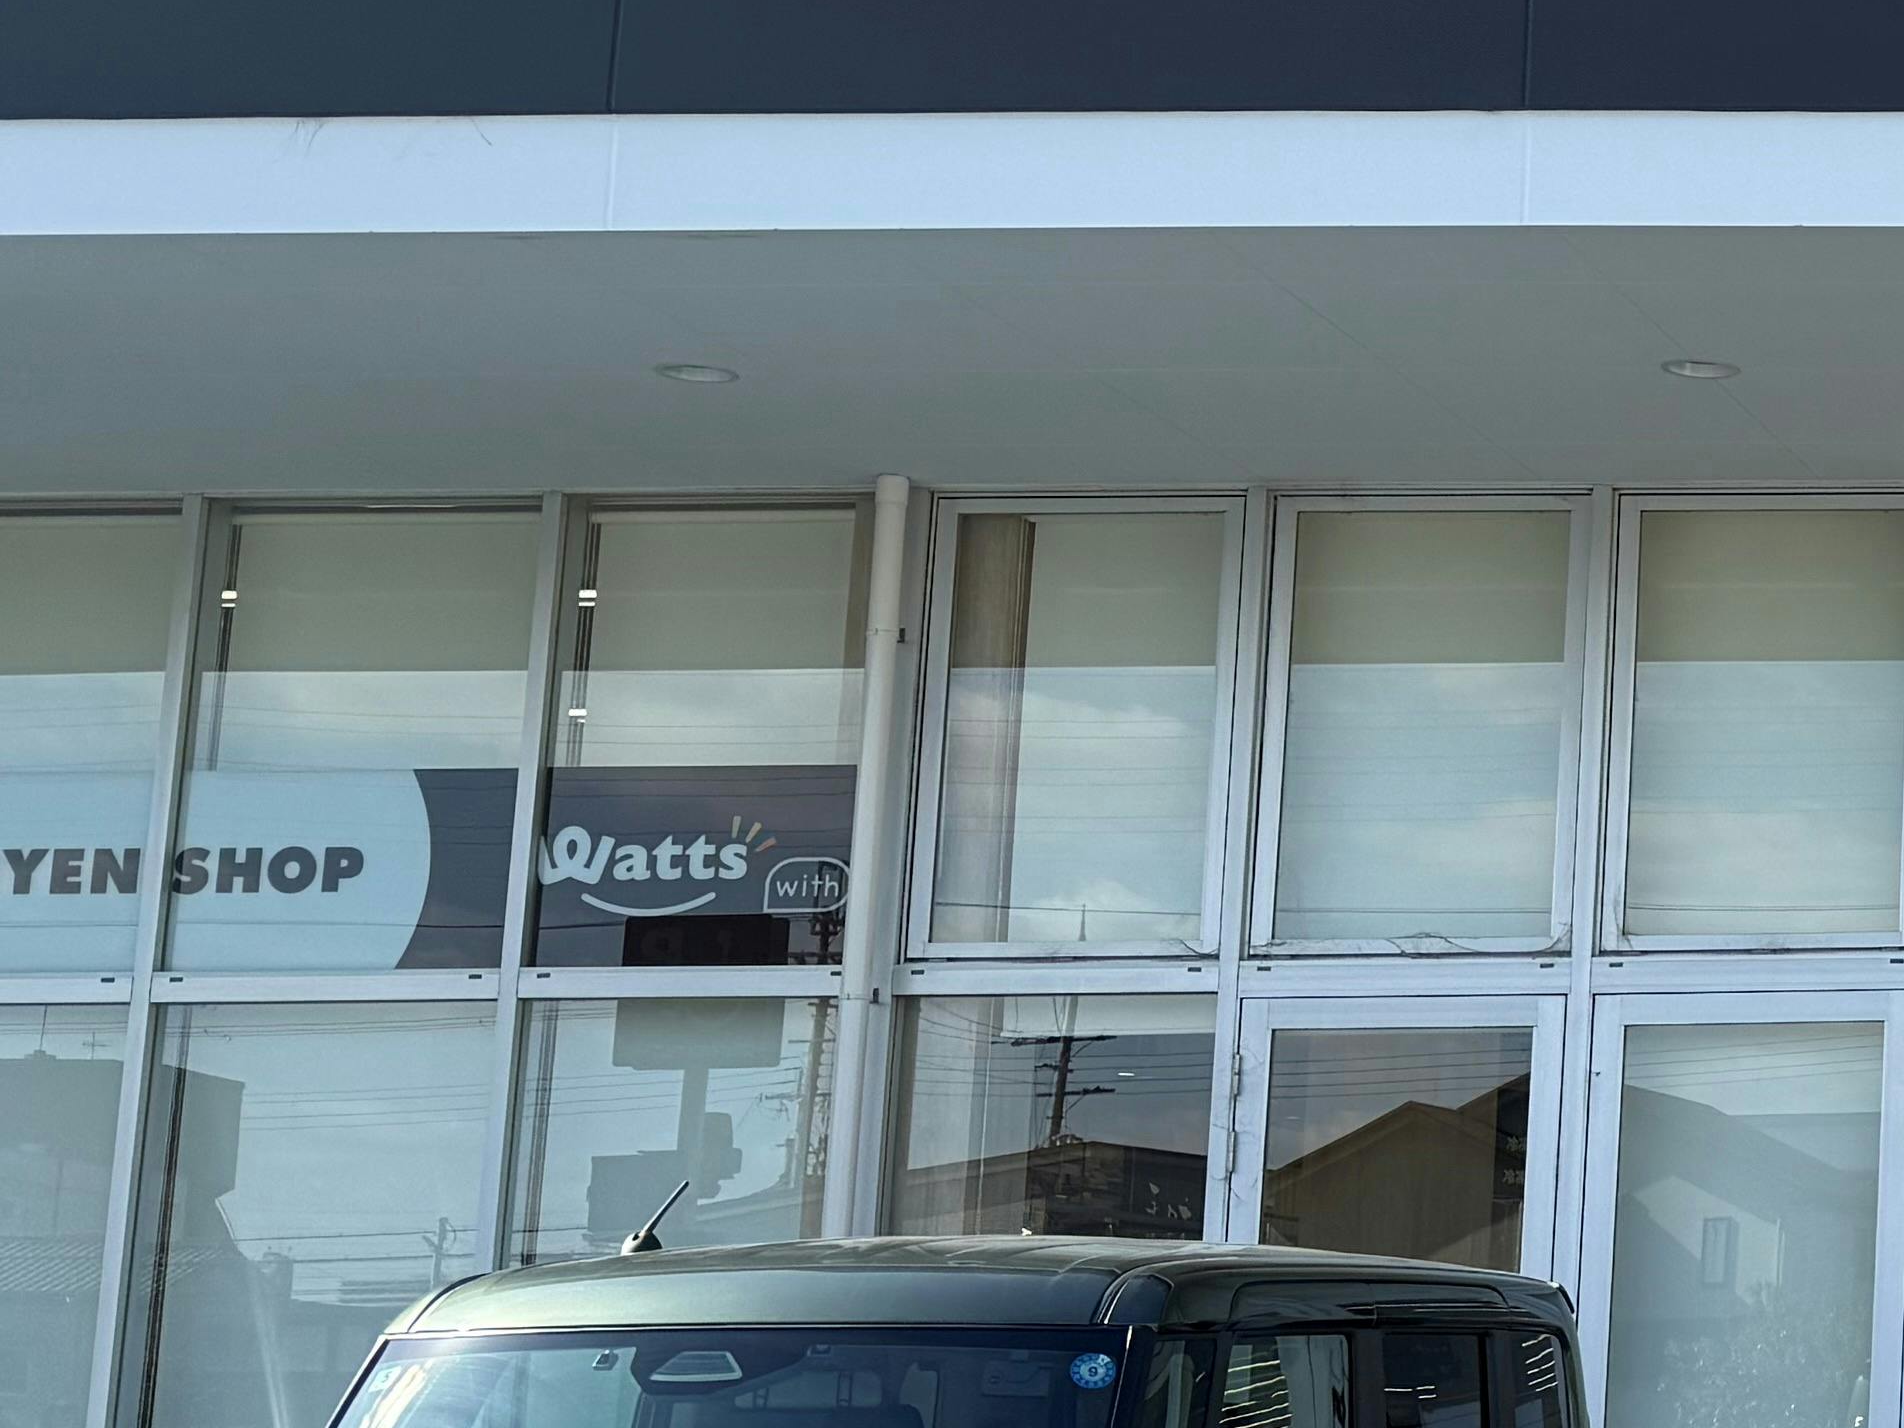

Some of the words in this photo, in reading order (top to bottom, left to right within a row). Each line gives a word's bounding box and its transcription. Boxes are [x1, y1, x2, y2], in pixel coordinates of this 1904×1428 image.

[3, 846, 141, 896] YEN
[172, 844, 366, 895] SHOP
[537, 823, 749, 886] Watts
[775, 873, 841, 900] with
